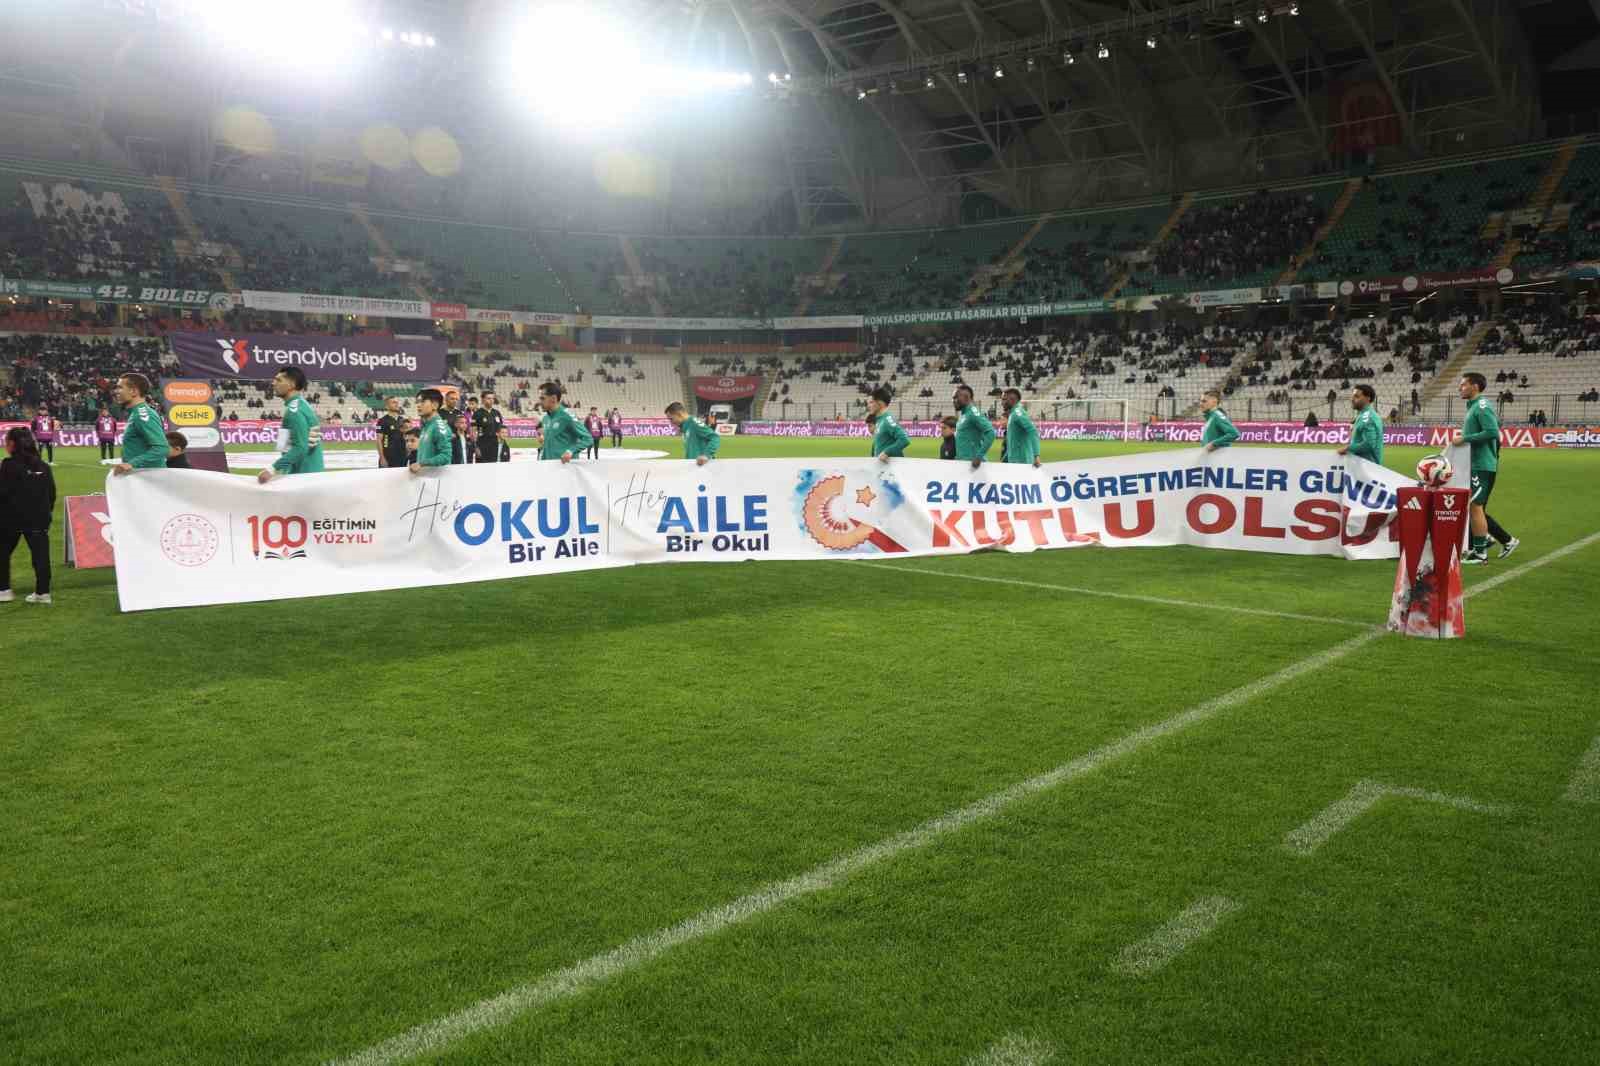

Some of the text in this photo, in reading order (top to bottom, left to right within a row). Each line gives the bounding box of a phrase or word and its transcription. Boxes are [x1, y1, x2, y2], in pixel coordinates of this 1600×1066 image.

[97, 285, 133, 299] 42.
[1010, 302, 1052, 317] DİLERİM
[252, 345, 348, 368] trendyol
[175, 410, 209, 420] NESİNE
[221, 428, 281, 444] urknet
[1274, 426, 1350, 443] turknet
[926, 480, 960, 503] 24
[968, 482, 1043, 505] KASIM
[1050, 466, 1289, 503] ÖĞRETMENLER
[656, 484, 768, 534] AİLE
[312, 518, 377, 535] EĞİTİMİN
[453, 496, 600, 547] OKUL
[930, 493, 1400, 549] KUTLU OLSU
[248, 515, 308, 559] 100
[313, 536, 374, 549] YÜZYILI
[666, 534, 769, 553] Bir Okul
[510, 536, 600, 563] Bir Aile
